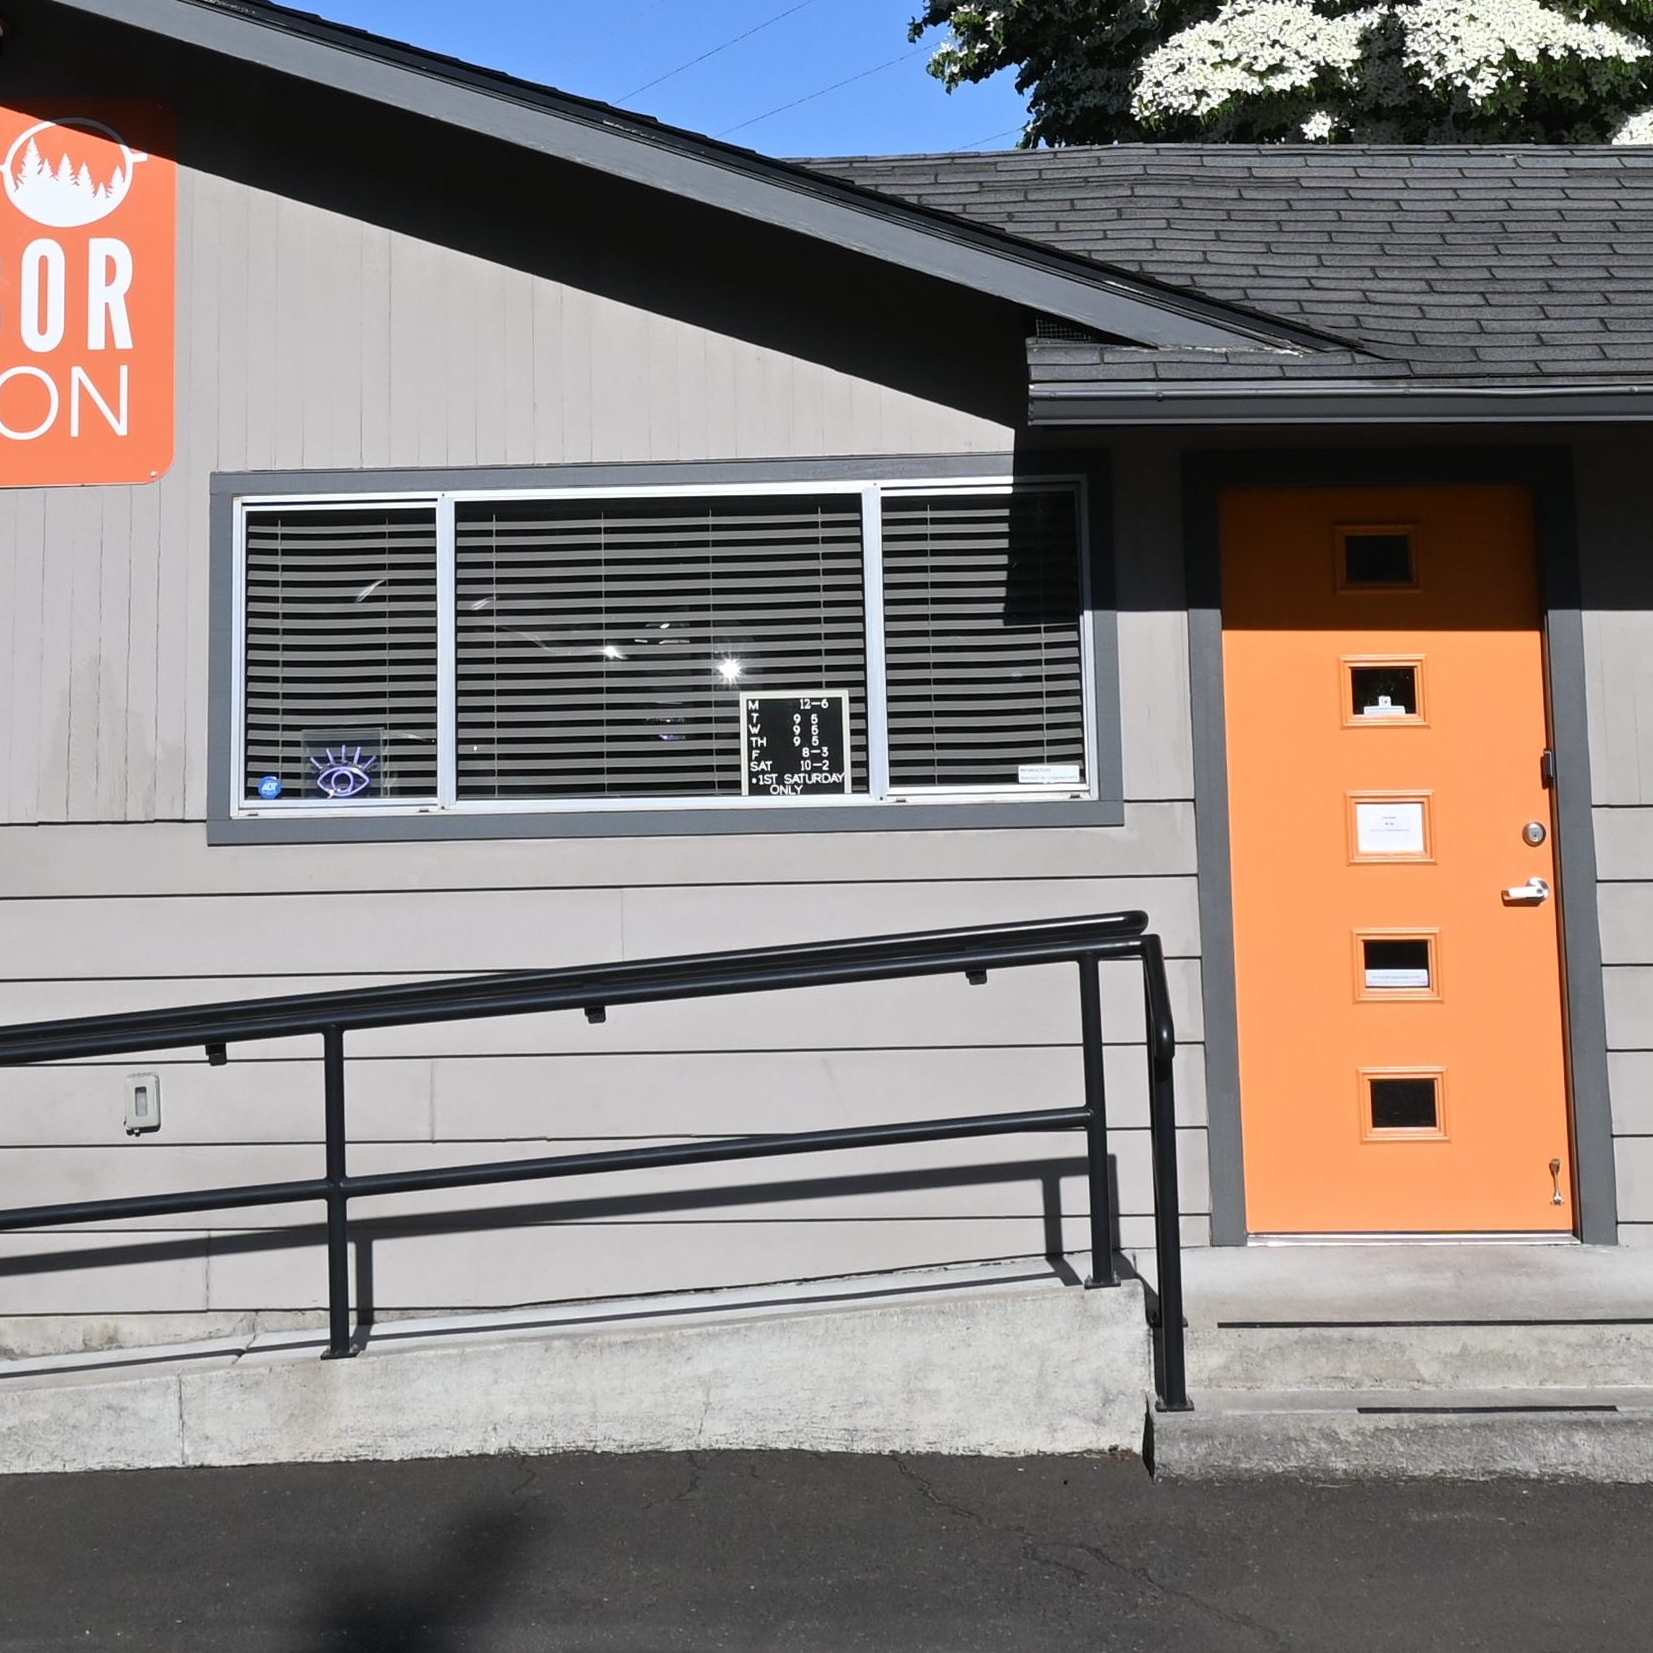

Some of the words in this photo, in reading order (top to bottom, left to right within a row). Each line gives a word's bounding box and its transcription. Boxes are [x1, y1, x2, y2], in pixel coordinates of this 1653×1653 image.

[748, 700, 759, 710] M
[750, 712, 759, 724] T
[793, 713, 801, 724] 9
[810, 713, 818, 724] 5
[748, 724, 761, 734] W
[793, 725, 801, 735] 9
[811, 725, 819, 735] 5
[750, 736, 767, 748] TH
[793, 736, 801, 747] 9
[811, 735, 819, 746] 5
[752, 750, 760, 760] F
[750, 760, 773, 772] SAT
[784, 771, 845, 784] SATURDAY
[769, 784, 803, 795] ONLY
